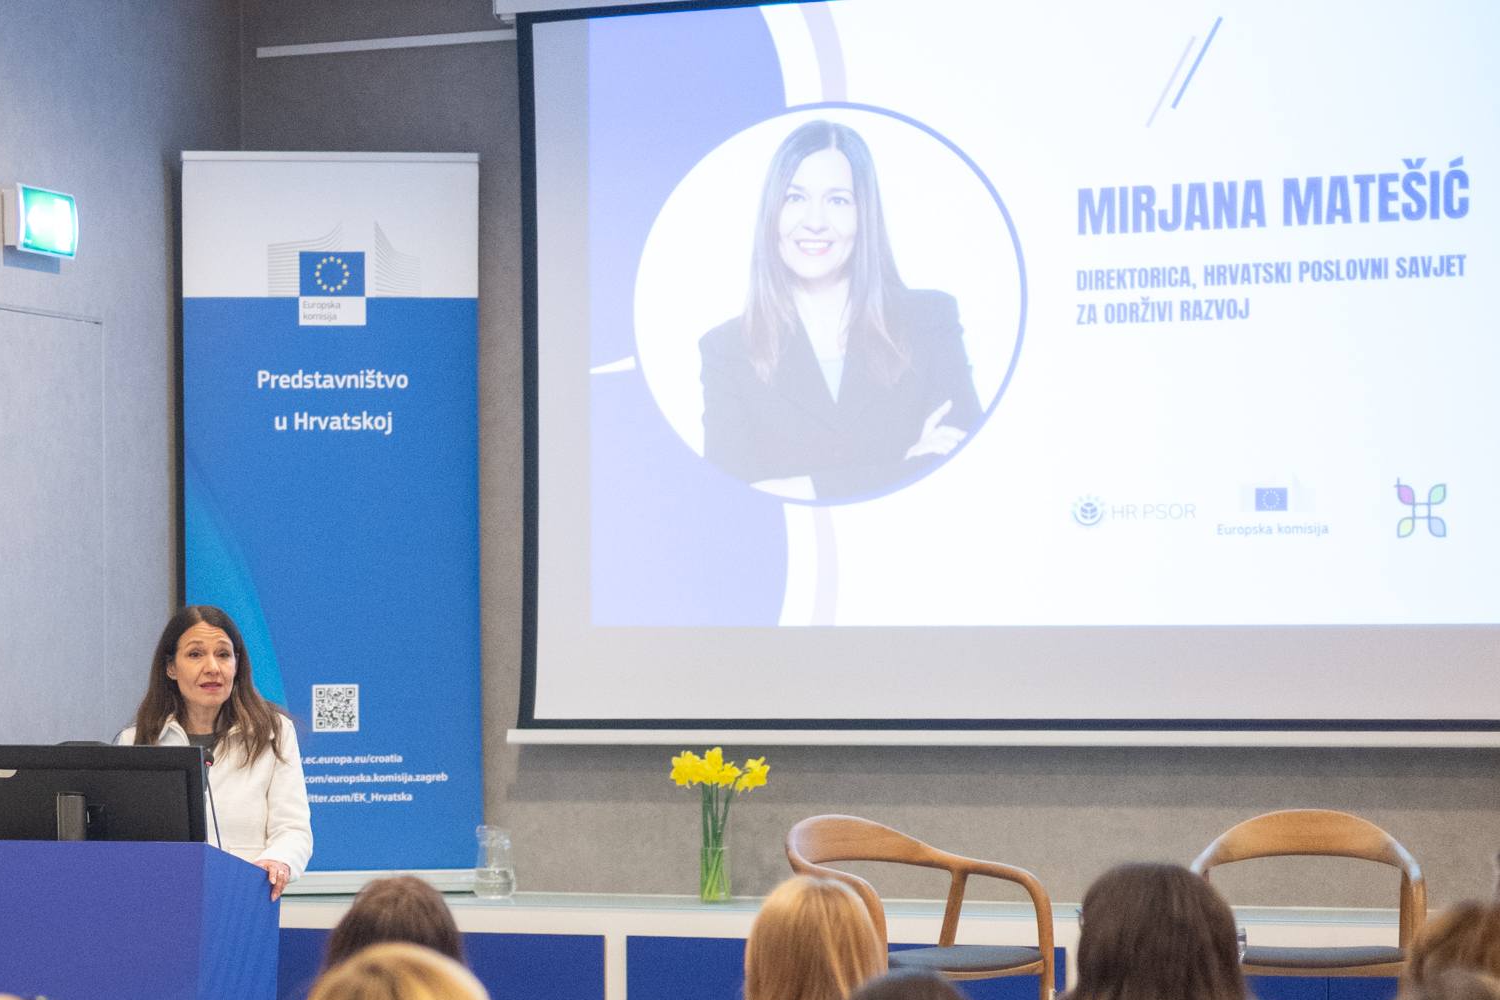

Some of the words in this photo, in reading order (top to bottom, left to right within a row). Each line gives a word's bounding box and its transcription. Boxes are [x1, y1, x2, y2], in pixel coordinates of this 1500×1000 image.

[1077, 180, 1267, 236] MIRJANA
[1282, 156, 1470, 227] MATEŠIĆ
[1076, 265, 1197, 291] DIREKTORICA,
[1203, 260, 1292, 286] HRVATSKI
[1298, 257, 1389, 283] POSLOVNI
[1395, 254, 1467, 279] SAVJET
[302, 301, 341, 312] Europska
[302, 311, 338, 323] komisija
[1076, 303, 1098, 325] ZA
[1103, 297, 1173, 324] ODRŽIVI
[1179, 297, 1250, 321] RAZVOJ
[257, 370, 408, 389] Predstavništvo
[275, 416, 287, 430] u
[294, 411, 393, 434] Hrvatskoj
[1216, 523, 1274, 536] Europska
[1277, 521, 1329, 536] komisija
